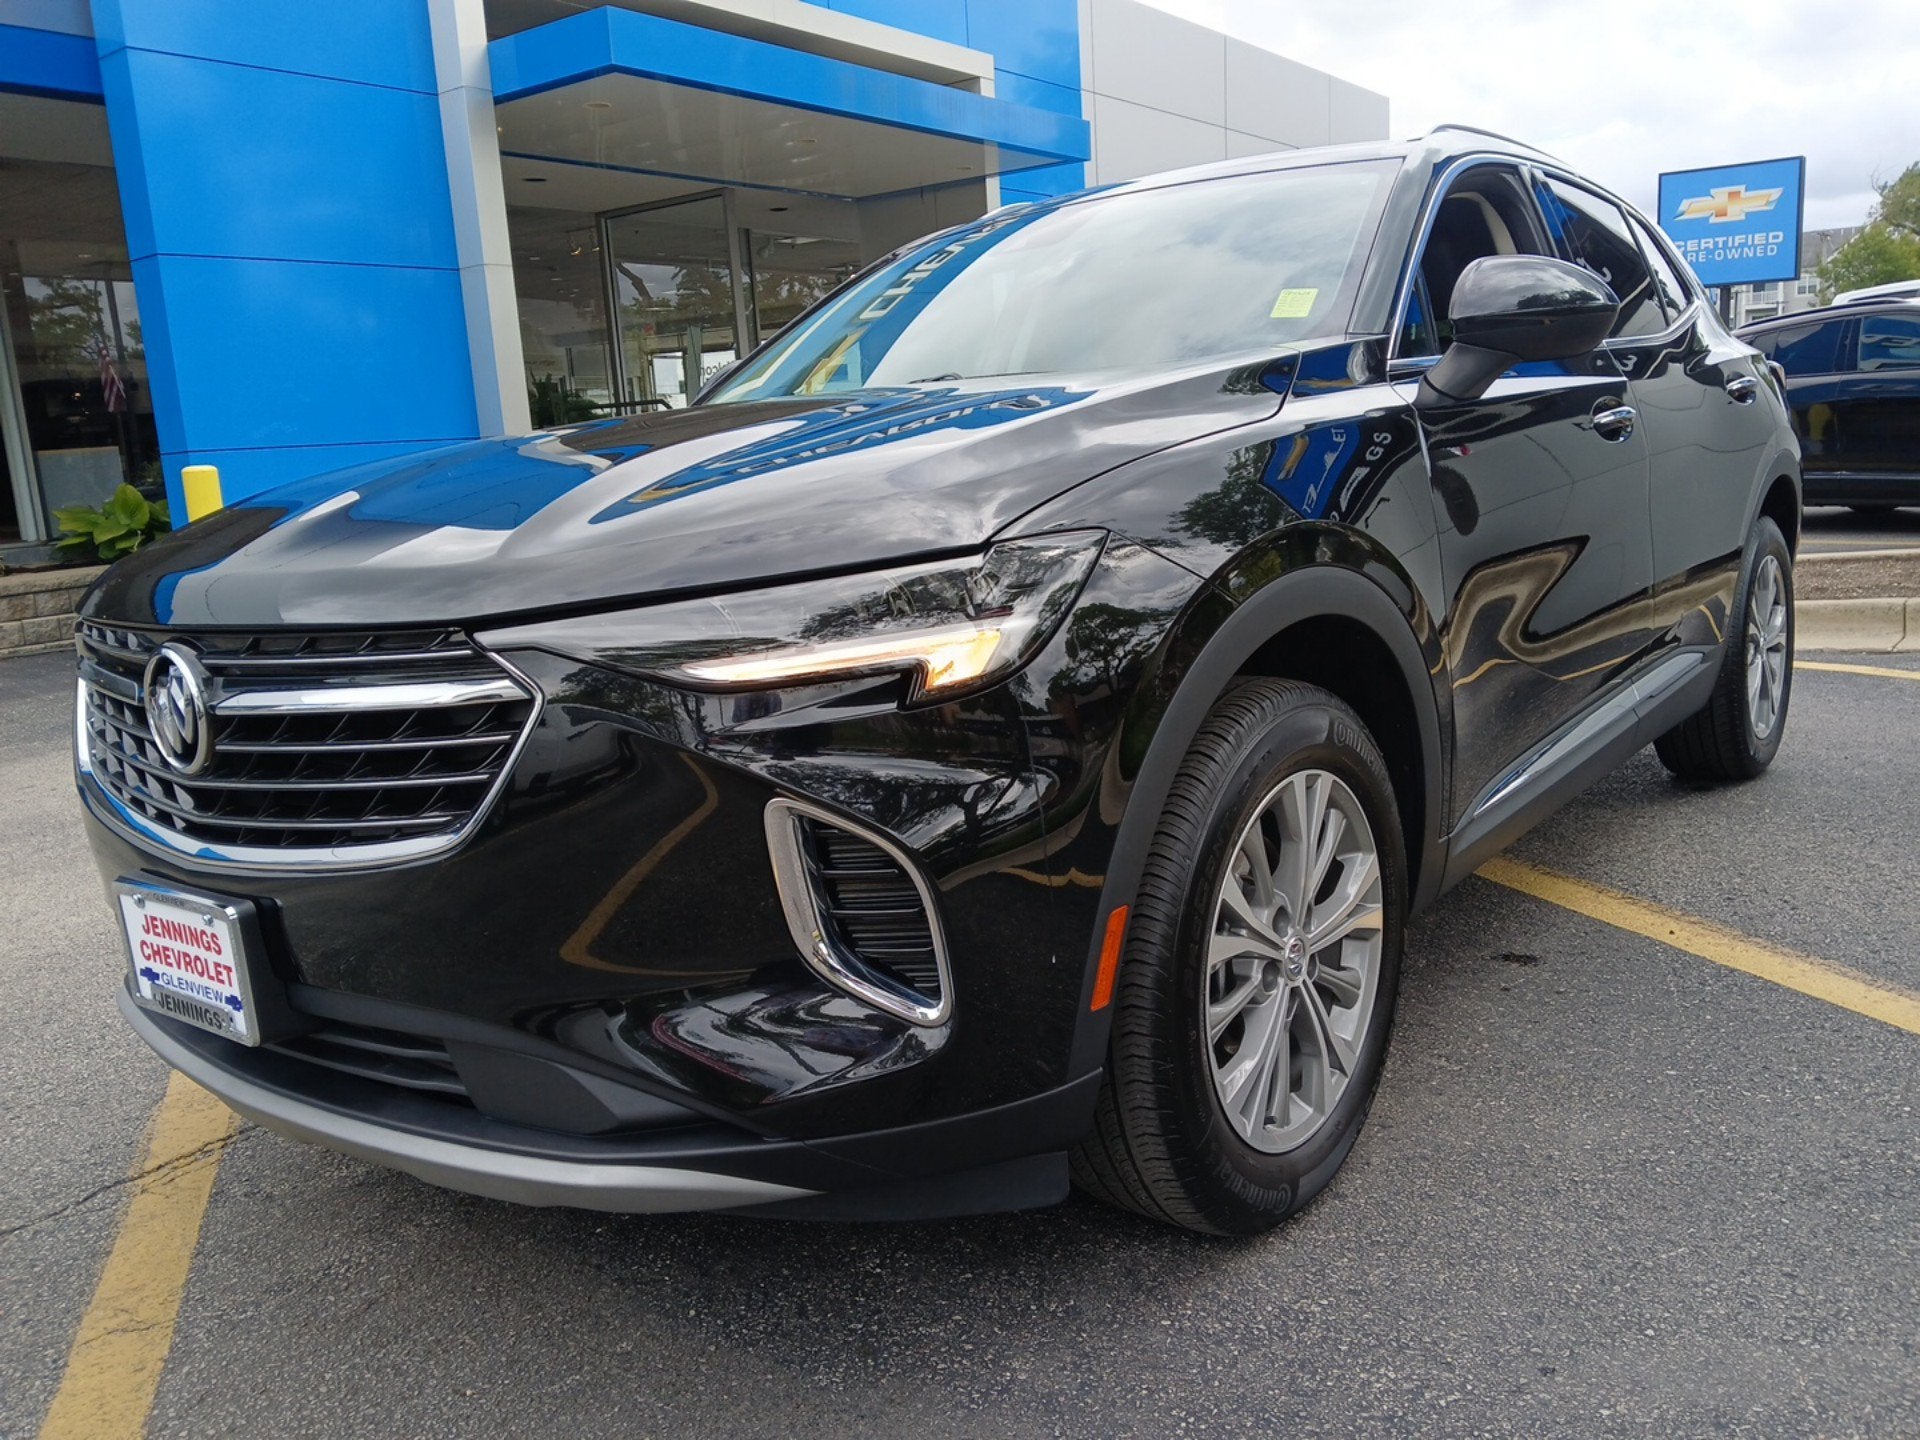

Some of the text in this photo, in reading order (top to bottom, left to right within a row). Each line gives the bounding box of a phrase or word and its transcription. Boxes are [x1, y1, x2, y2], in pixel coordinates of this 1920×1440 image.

[1674, 231, 1784, 251] CERTIFIED
[1682, 245, 1777, 263] RE-OWNED
[142, 914, 223, 956] JENNINGS
[140, 940, 234, 988] CHEVROLET
[161, 972, 224, 1004] GLENVIEW
[158, 991, 222, 1030] JENNINGS
